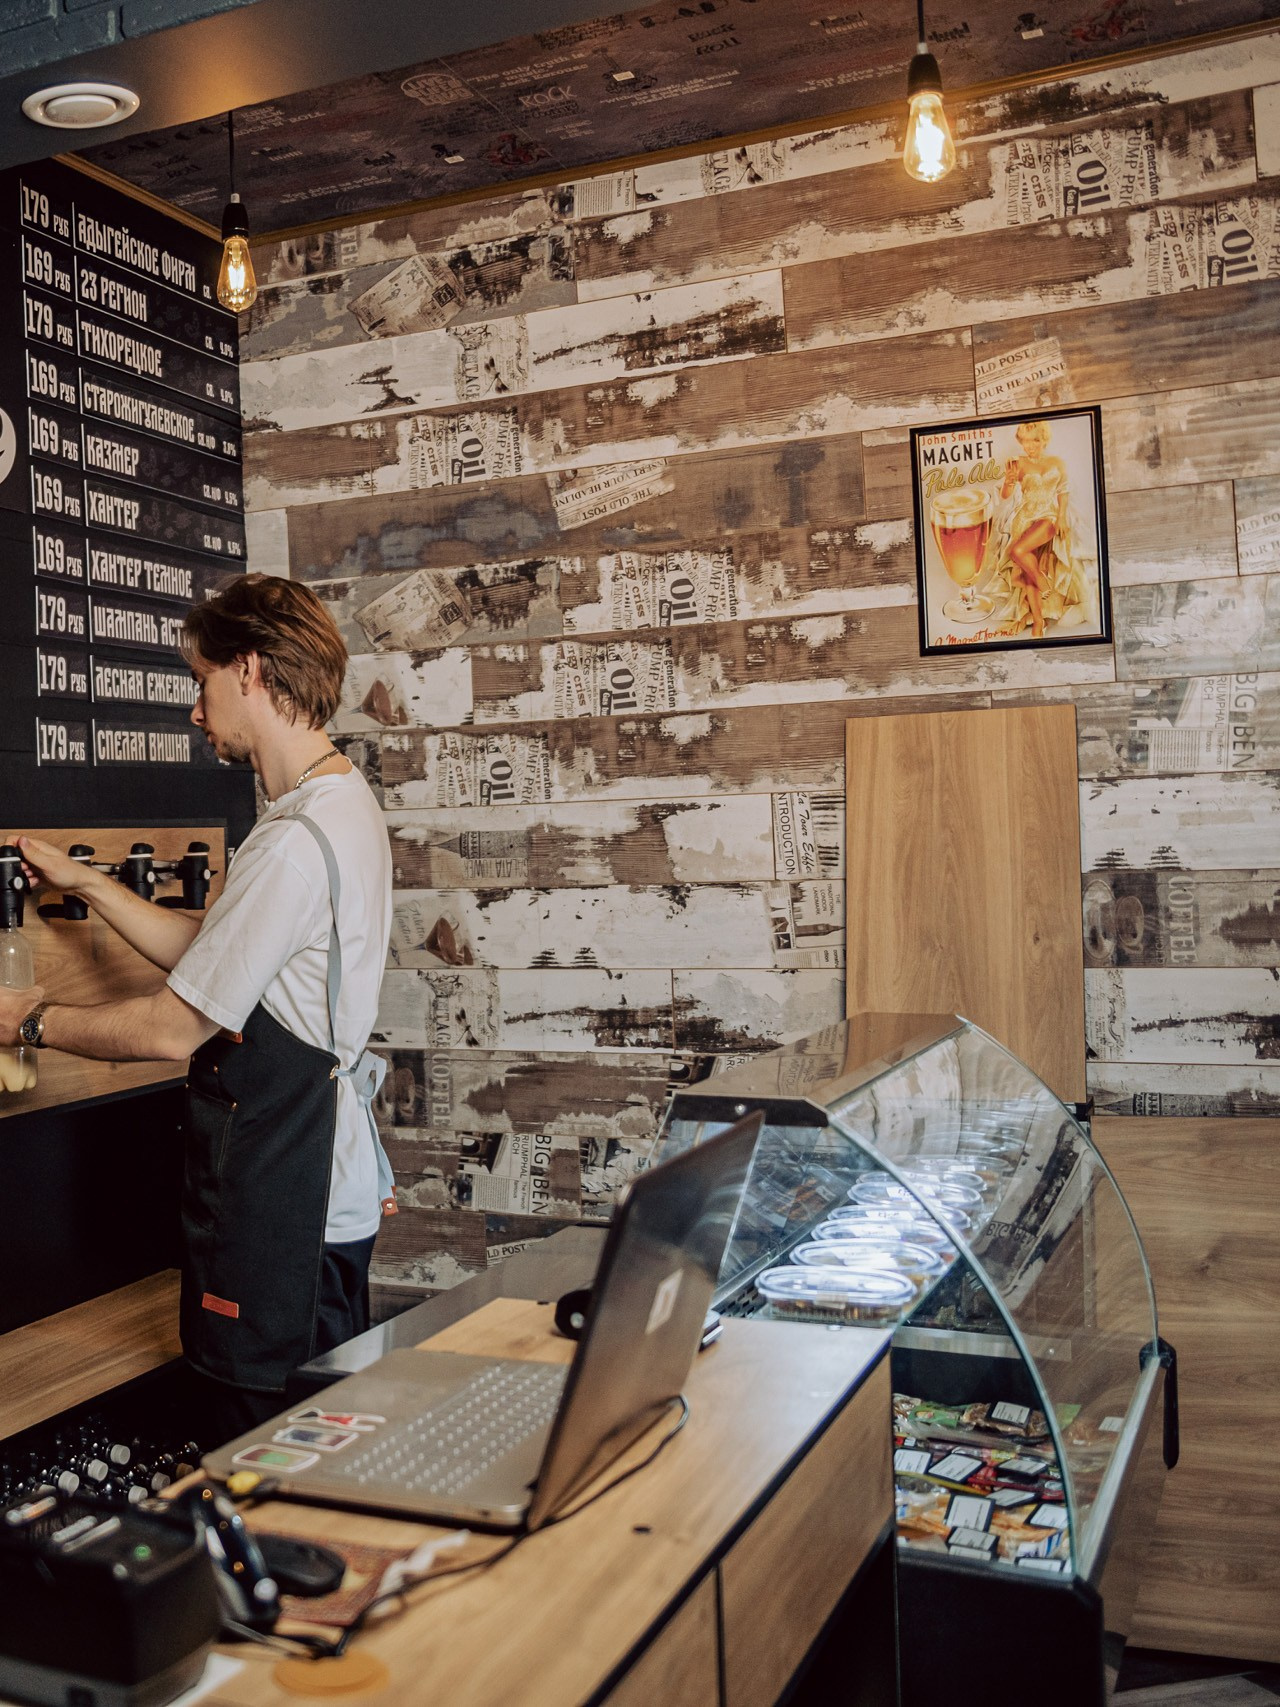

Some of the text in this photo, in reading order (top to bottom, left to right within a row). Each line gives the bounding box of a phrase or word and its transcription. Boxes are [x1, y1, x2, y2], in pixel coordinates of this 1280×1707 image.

[1076, 159, 1111, 208] Oil
[22, 186, 49, 229] 179
[53, 214, 69, 238] РУБ
[78, 213, 159, 274] АДЫГЕЙСКОЕ
[161, 250, 196, 293] ФИРМ
[1222, 229, 1259, 278] Oil
[26, 242, 53, 286] 169
[55, 270, 71, 293] РУБ
[80, 269, 97, 302] 23
[100, 276, 147, 323] РЕГИОН
[27, 298, 53, 340] 179
[57, 324, 73, 347] РУБ
[81, 321, 162, 378] ТИХОРЕЦКОЕ
[999, 349, 1030, 367] POST
[30, 357, 58, 398] 169
[60, 382, 75, 405] РУБ
[84, 381, 195, 443] СТАРОЖИГУЛЕВСКОЕ
[32, 414, 58, 451] 169
[62, 439, 78, 461] РУБ
[461, 437, 486, 478] Oil
[921, 427, 993, 446] John Smith's
[923, 441, 994, 467] MAGNET
[35, 473, 62, 513] 169
[64, 496, 81, 518] РУБ
[89, 490, 139, 530] ХАНТЕР
[922, 458, 1006, 498] Pale Ale
[583, 506, 608, 521] POST
[37, 534, 192, 598] 169 РУБ ХАНТЕР ТЕМНОЕ
[39, 594, 66, 633] 179
[68, 614, 84, 635] РУБ
[94, 606, 158, 644] ШАМПАНЬ
[670, 578, 698, 620] Oil
[39, 655, 66, 691] 179
[71, 674, 86, 693] РУБ
[96, 666, 144, 700] ЛЕСНАЯ
[611, 668, 637, 710] Oil
[40, 725, 190, 763] 179 РУБ СПЕЛАЯ ВИШНЯ
[1232, 673, 1258, 768] BIG BEN
[490, 760, 515, 800] Oil
[531, 1134, 552, 1215] BIG BEN
